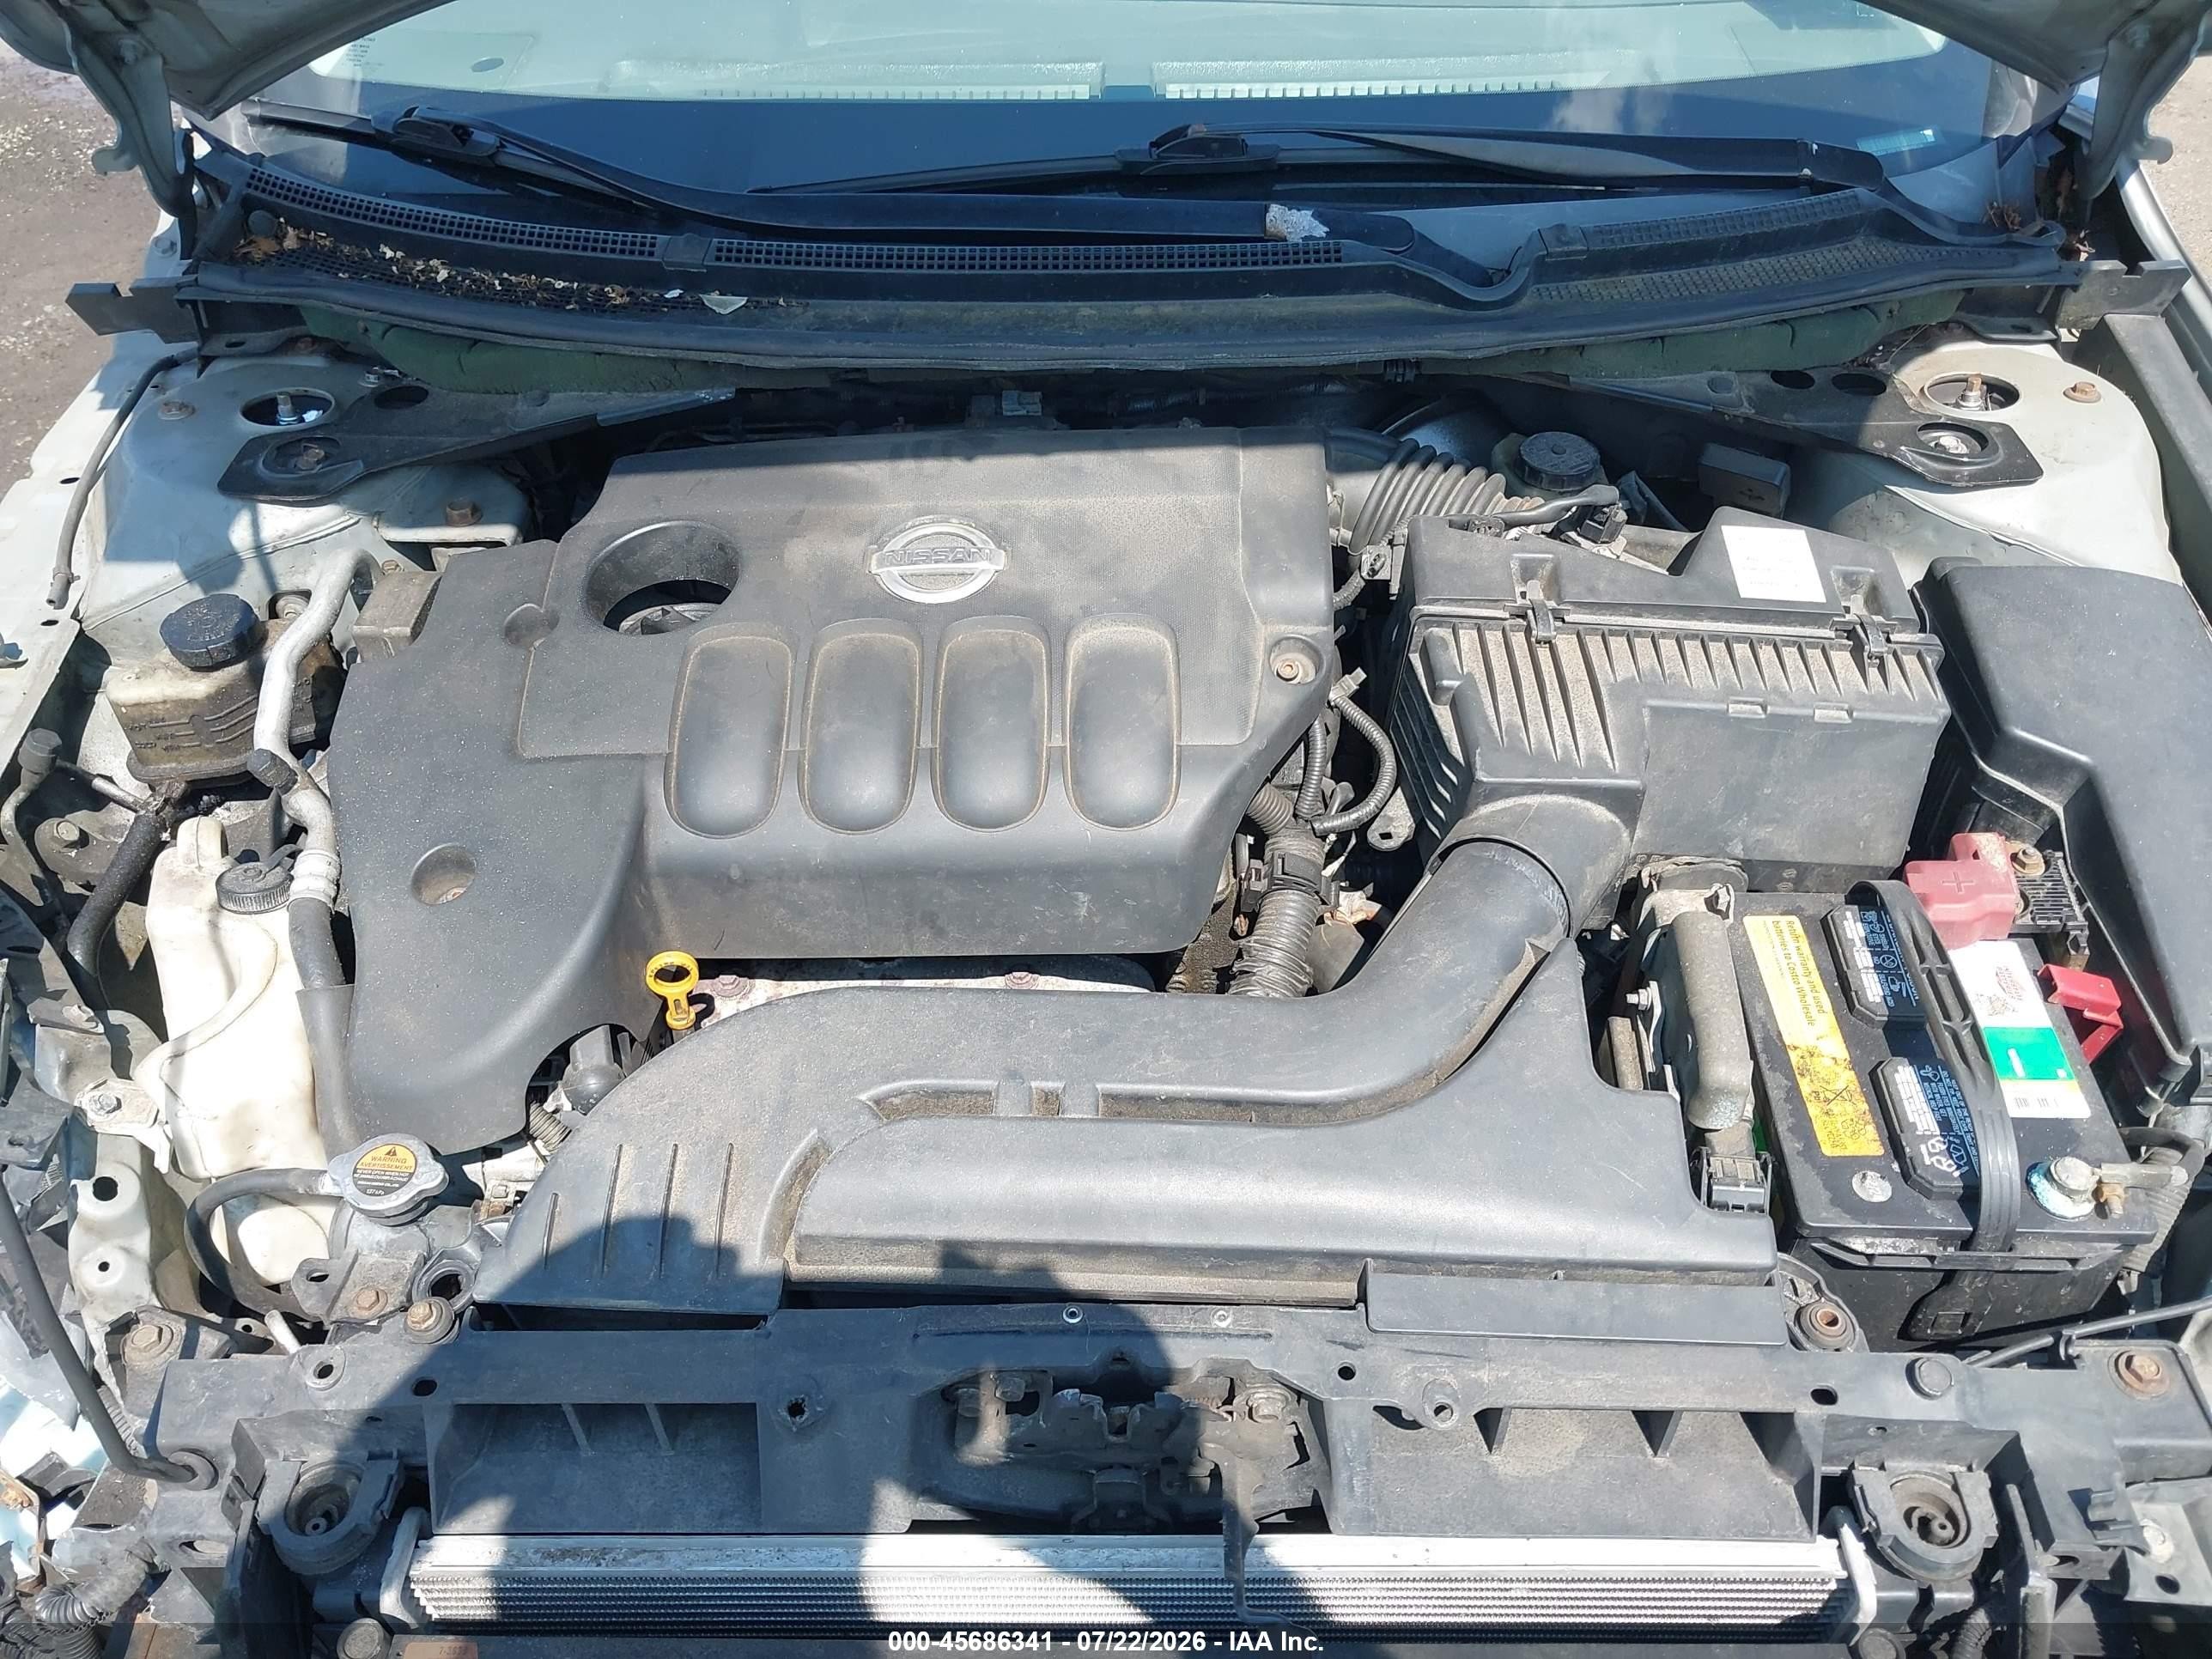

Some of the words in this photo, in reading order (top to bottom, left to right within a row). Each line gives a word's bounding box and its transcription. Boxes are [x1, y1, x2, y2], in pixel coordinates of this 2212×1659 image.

[884, 549, 990, 564] NISSAN
[1771, 921, 1789, 950] batteries
[1786, 963, 1801, 985] Costco
[1795, 988, 1816, 1026] Wholesale
[1786, 921, 1800, 944] Return
[1795, 946, 1812, 977] warranty
[1807, 981, 1820, 993] and
[1814, 996, 1827, 1014] used
[359, 1162, 413, 1170] AVERTISSEMENT
